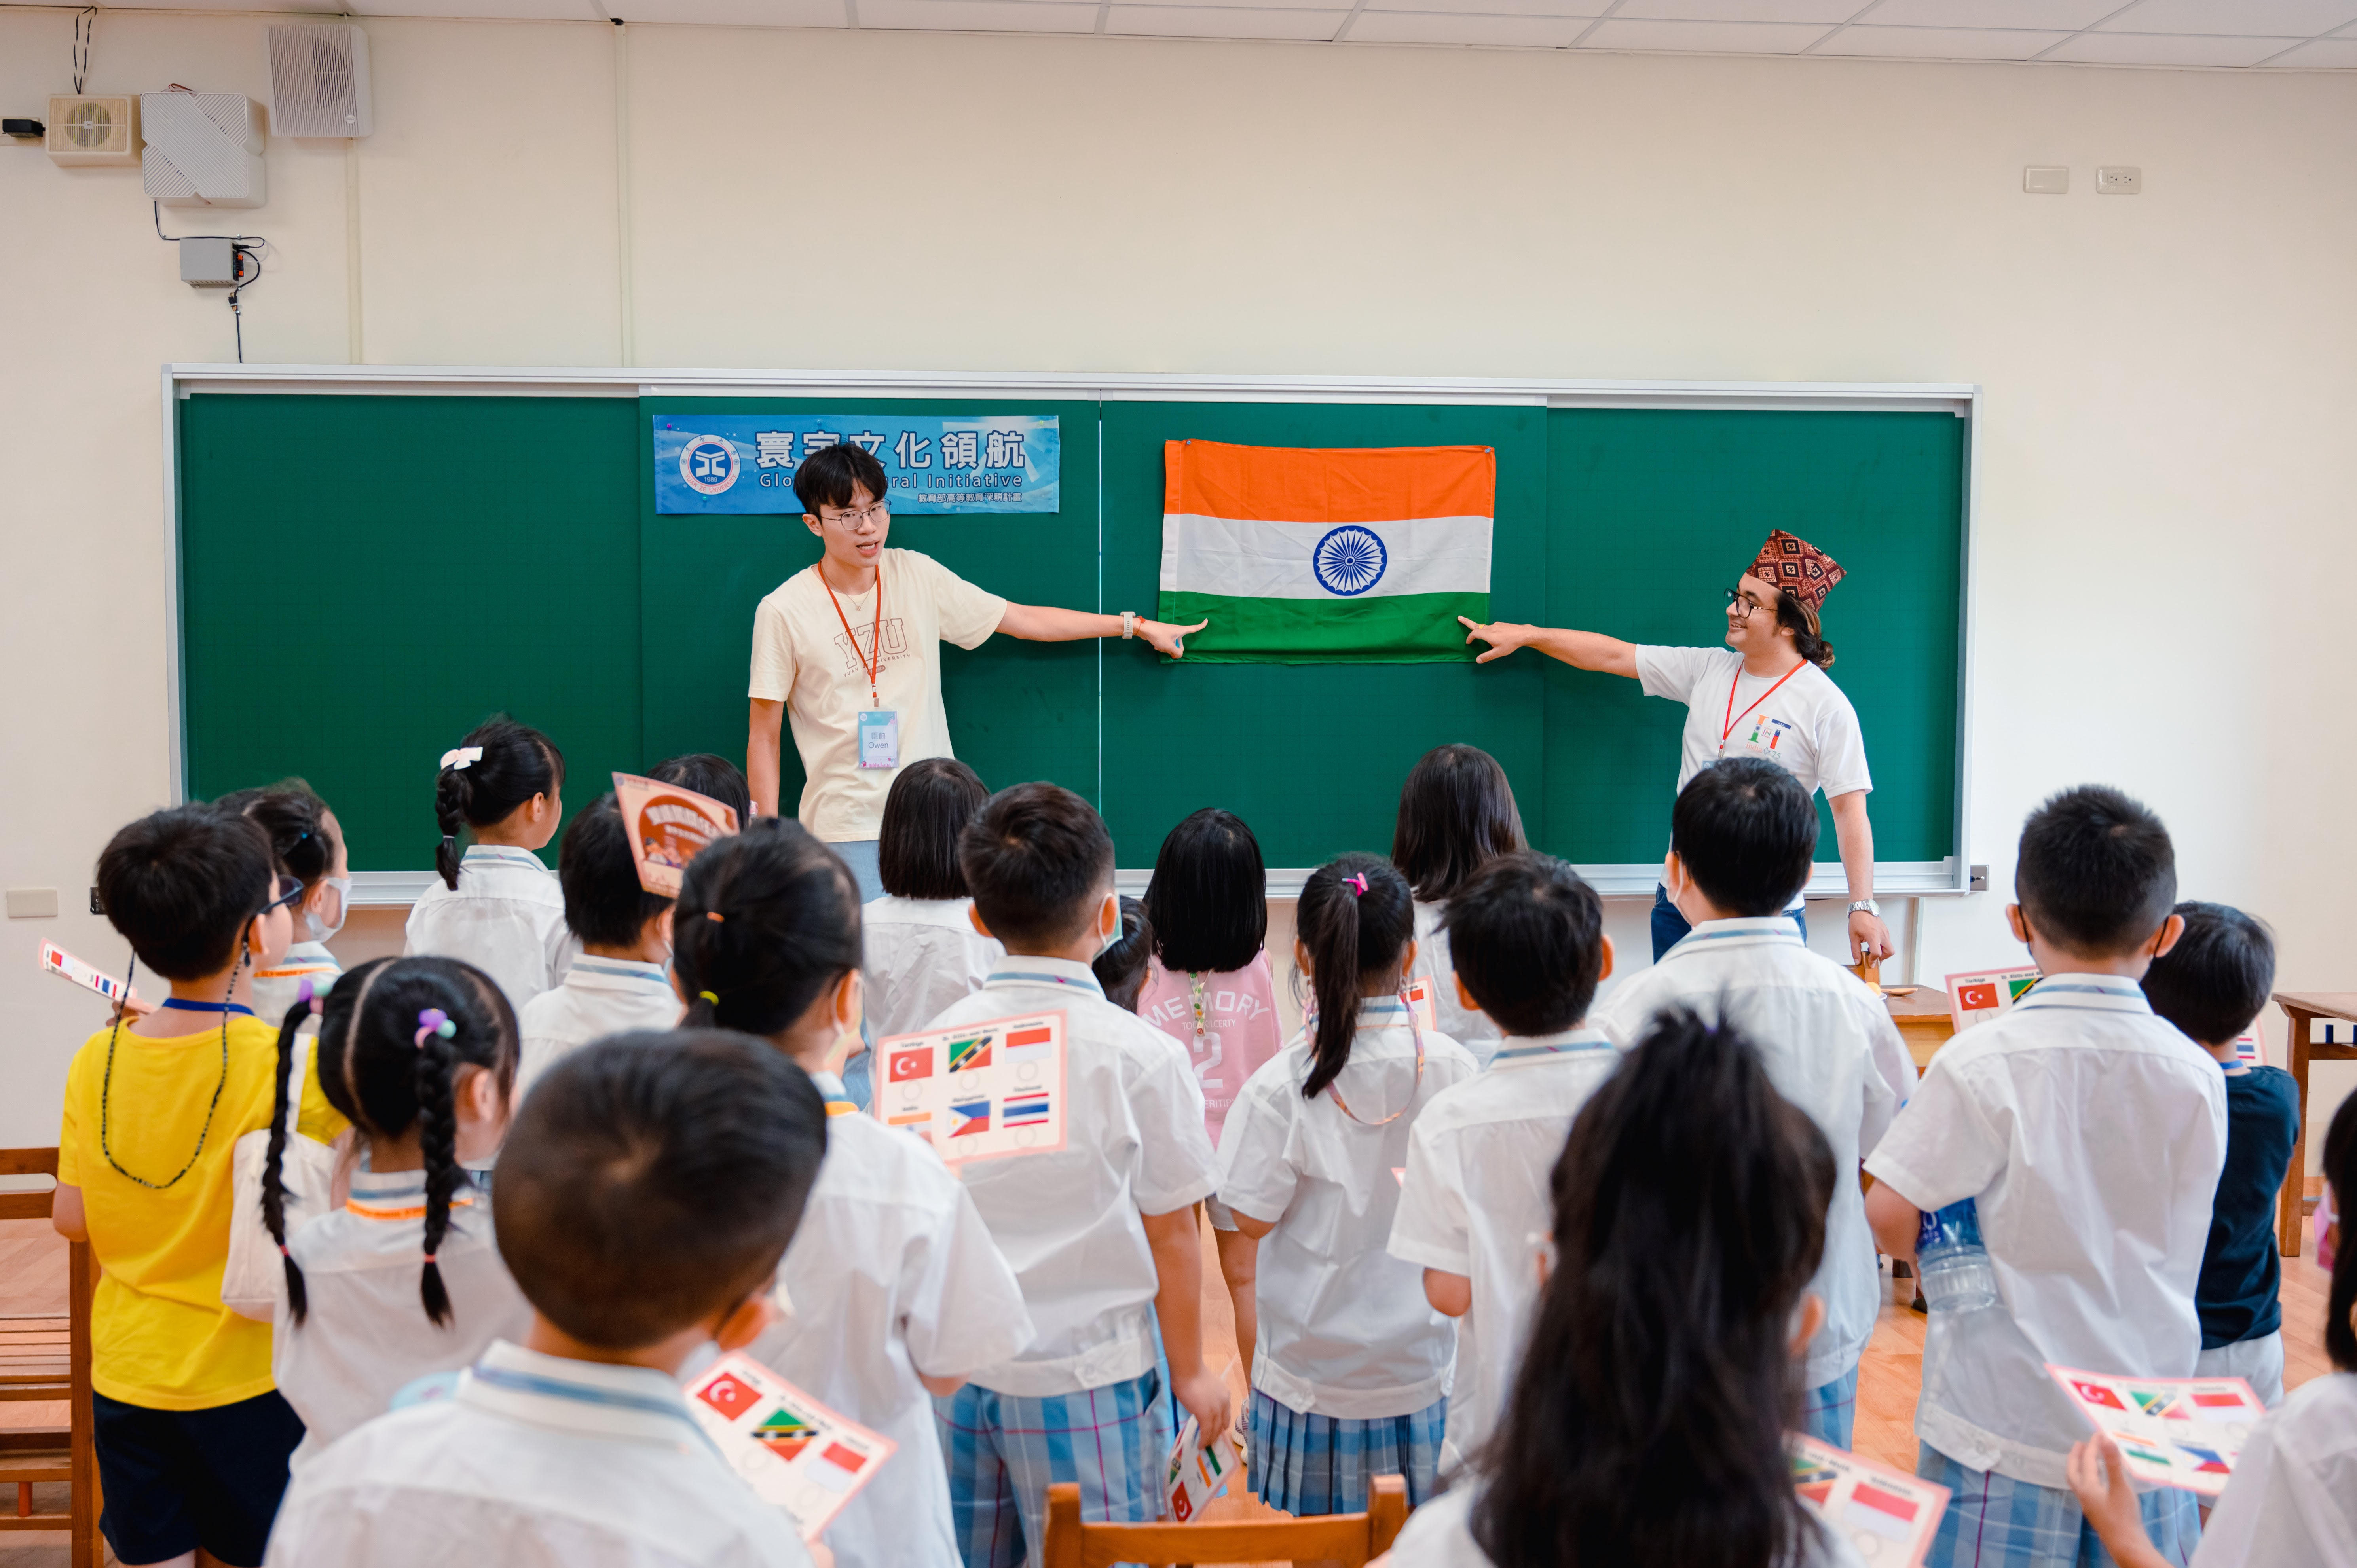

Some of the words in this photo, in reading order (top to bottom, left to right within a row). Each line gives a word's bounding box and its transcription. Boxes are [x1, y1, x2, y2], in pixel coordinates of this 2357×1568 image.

[685, 474, 698, 488] YUAN
[709, 474, 736, 493] UNIVERSITY
[928, 473, 1022, 487] Initiative
[834, 618, 907, 669] YZU
[843, 667, 859, 677] YUAN
[876, 654, 911, 664] NIVERSITY
[1746, 741, 1763, 753] India
[1772, 751, 1781, 759] 75
[1141, 990, 1270, 1027] MEMORY
[1193, 1031, 1223, 1089] 2
